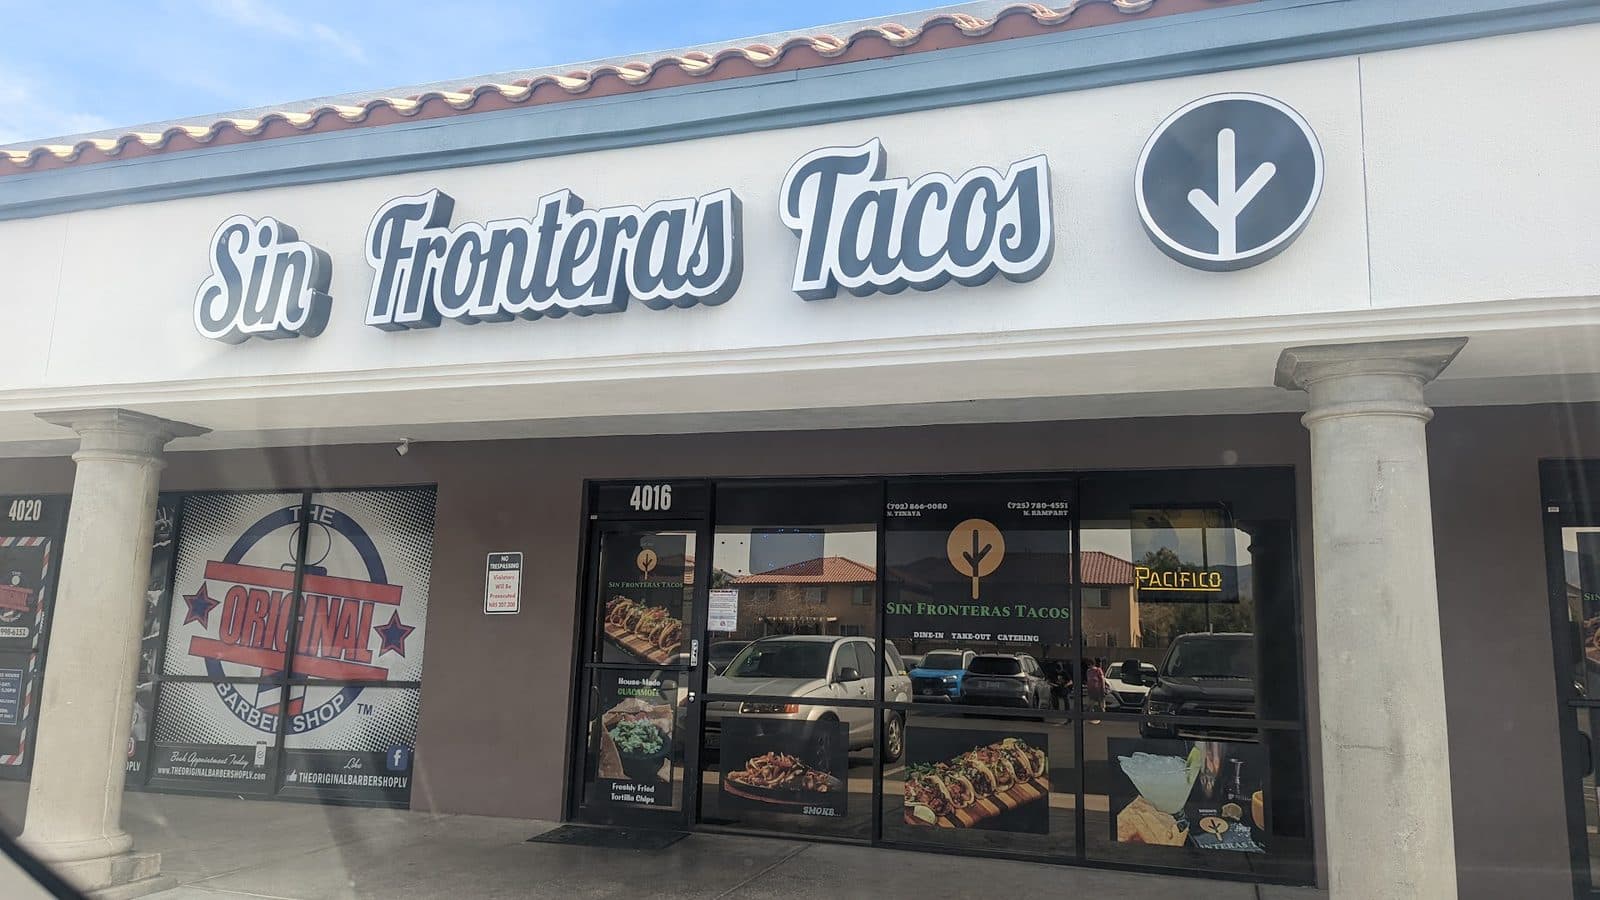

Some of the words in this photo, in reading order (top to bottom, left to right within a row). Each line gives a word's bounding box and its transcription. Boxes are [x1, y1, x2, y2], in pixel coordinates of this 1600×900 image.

[199, 220, 314, 336] Sin
[368, 198, 731, 319] Fronteras
[784, 146, 1045, 287] Tacos
[629, 484, 672, 511] 4016
[886, 502, 908, 510] (702)
[8, 499, 42, 521] 4020
[288, 504, 336, 525] THE
[1135, 567, 1222, 590] PACIFICO
[886, 602, 913, 615] SIN
[917, 602, 1011, 617] FRONTERAS
[1014, 604, 1070, 619] TACOS
[218, 584, 375, 664] ORIGINAL
[913, 631, 944, 639] DINE-IN
[997, 634, 1039, 642] CATERING
[618, 677, 661, 686] House-Made
[617, 687, 660, 697] GUACAMOLE
[292, 694, 346, 733] SHOP
[356, 703, 374, 716] TM
[170, 751, 188, 763] Book
[187, 751, 228, 767] Appointment
[227, 753, 250, 770] Today
[299, 771, 408, 789] THEORIGINALBARBERSHOPLV
[612, 782, 636, 793] Freshly
[637, 784, 655, 793] Fried
[611, 792, 635, 801] Tortilla
[635, 794, 655, 804] Chips
